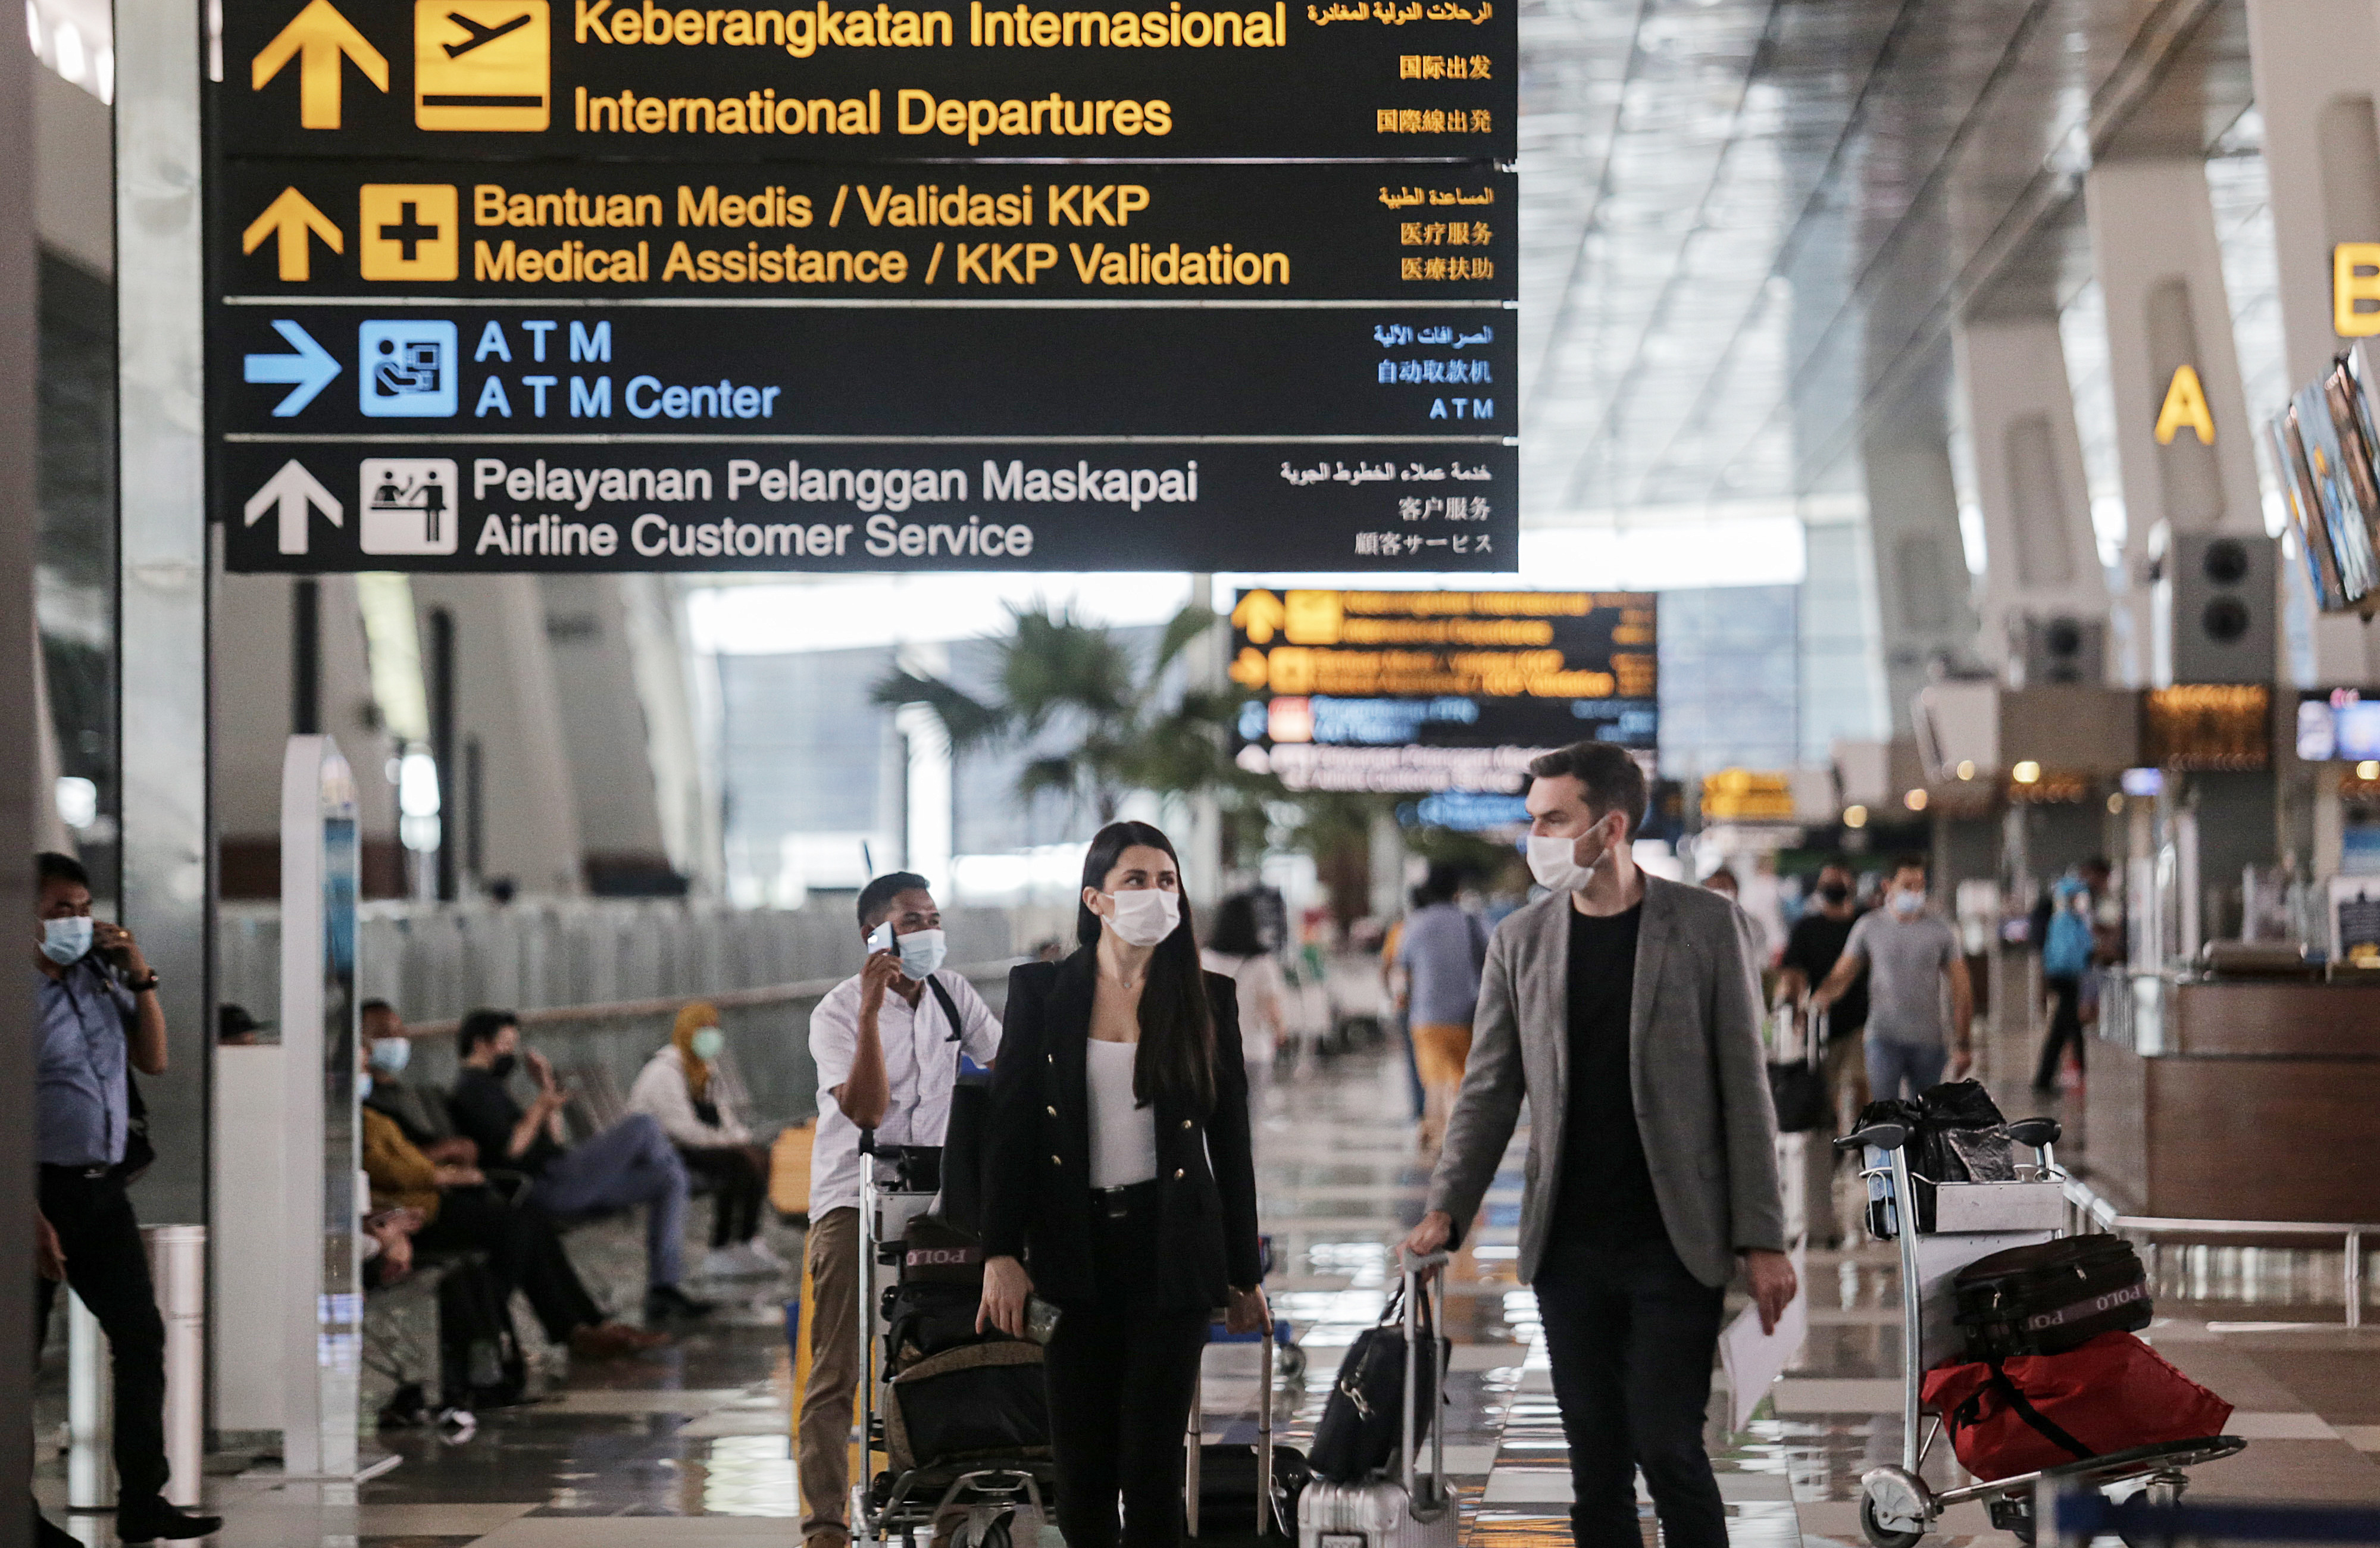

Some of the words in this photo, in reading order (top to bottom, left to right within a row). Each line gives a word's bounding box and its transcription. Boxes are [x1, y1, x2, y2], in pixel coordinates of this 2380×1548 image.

[1427, 2, 1492, 25] الرحلات
[575, 0, 953, 58] Keberangkatan
[971, 1, 1286, 47] Internasional
[1400, 55, 1491, 80] 国际出发
[576, 86, 880, 135] International
[898, 89, 1172, 146] Departures
[1377, 109, 1491, 134] 国際線出発
[474, 184, 662, 227] Bantuan
[678, 185, 813, 227] Medis
[829, 185, 849, 227] /
[857, 184, 1032, 227] Validasi
[1049, 185, 1150, 226] KKP
[1379, 187, 1425, 209] الطبية
[1429, 187, 1494, 205] المساعدة
[1401, 221, 1493, 246] 医疗服务
[474, 240, 649, 282] Medical
[662, 241, 908, 283] Assistance
[925, 242, 945, 284] /
[958, 243, 1058, 284] KKP
[1069, 243, 1290, 285] Validation
[1402, 257, 1494, 281] 医療扶助
[2333, 242, 2380, 337] B
[1378, 359, 1493, 383] 自动取款机
[625, 376, 781, 418] Center
[2155, 365, 2215, 445] A
[474, 459, 712, 510] Pelayanan
[728, 459, 968, 511] Pelanggan
[983, 460, 1197, 511] Maskapai
[1399, 496, 1491, 521] 客户服务
[476, 514, 618, 556] Airline
[631, 514, 853, 556] Customer
[865, 514, 1034, 556] Service
[1355, 531, 1492, 556] 顧客サービス
[906, 1249, 966, 1266] POLO
[2097, 1284, 2141, 1310] POLO
[2028, 1311, 2063, 1330] PO
